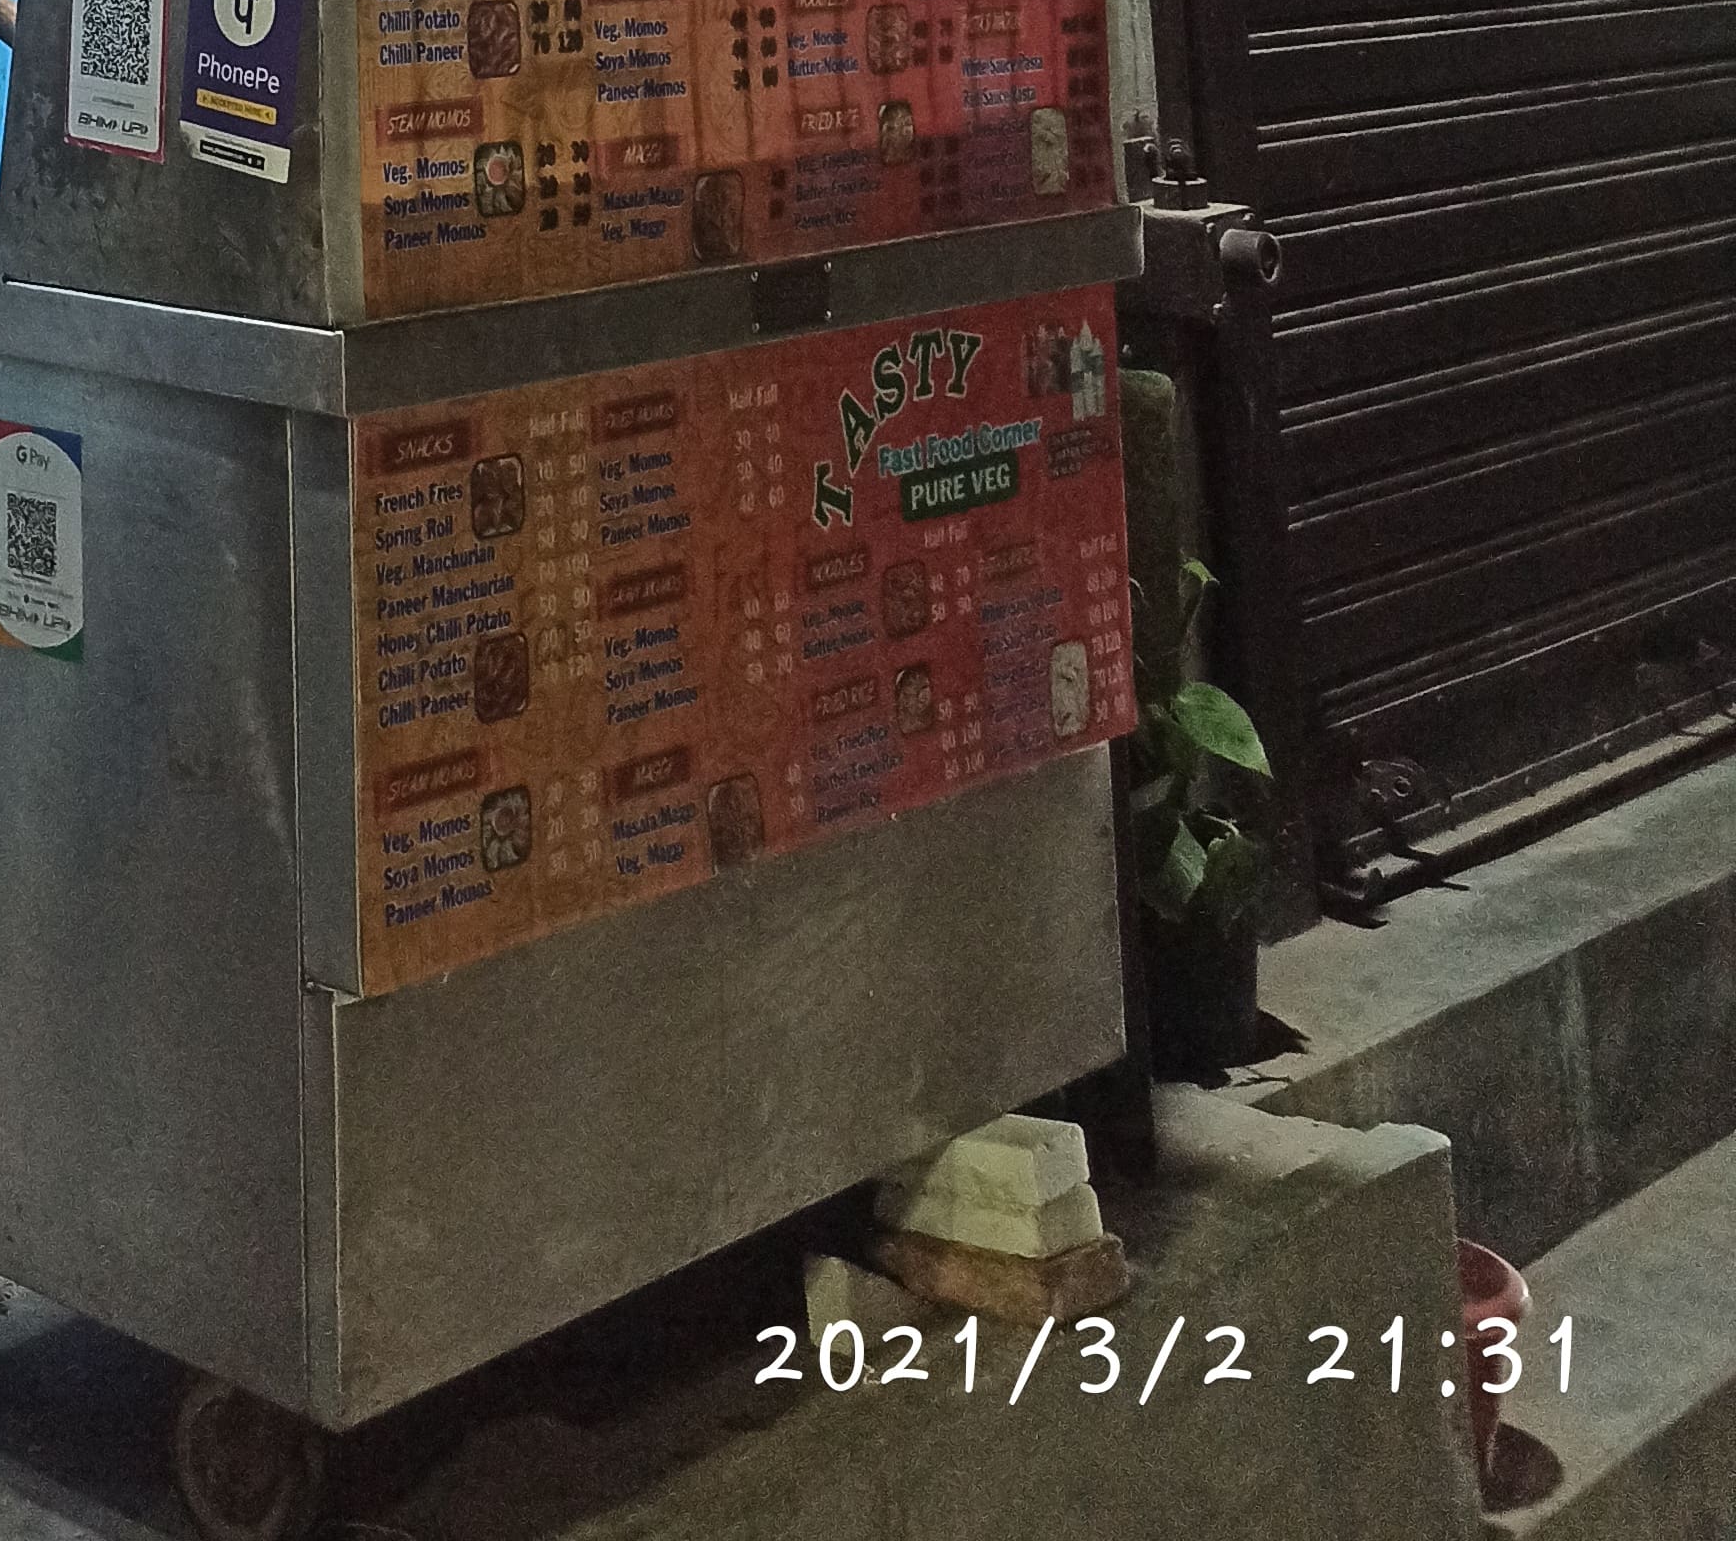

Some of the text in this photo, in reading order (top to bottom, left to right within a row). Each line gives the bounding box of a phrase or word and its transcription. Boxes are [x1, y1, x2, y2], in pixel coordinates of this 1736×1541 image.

[378, 8, 461, 33] Chilli Potato
[197, 52, 281, 94] PhonePe
[595, 47, 672, 72] Soya Momos
[812, 327, 983, 530] TASTY
[877, 440, 924, 478] Fast
[925, 429, 975, 469] Food
[977, 417, 1043, 454] Corner
[910, 463, 1011, 511] PURE VEG
